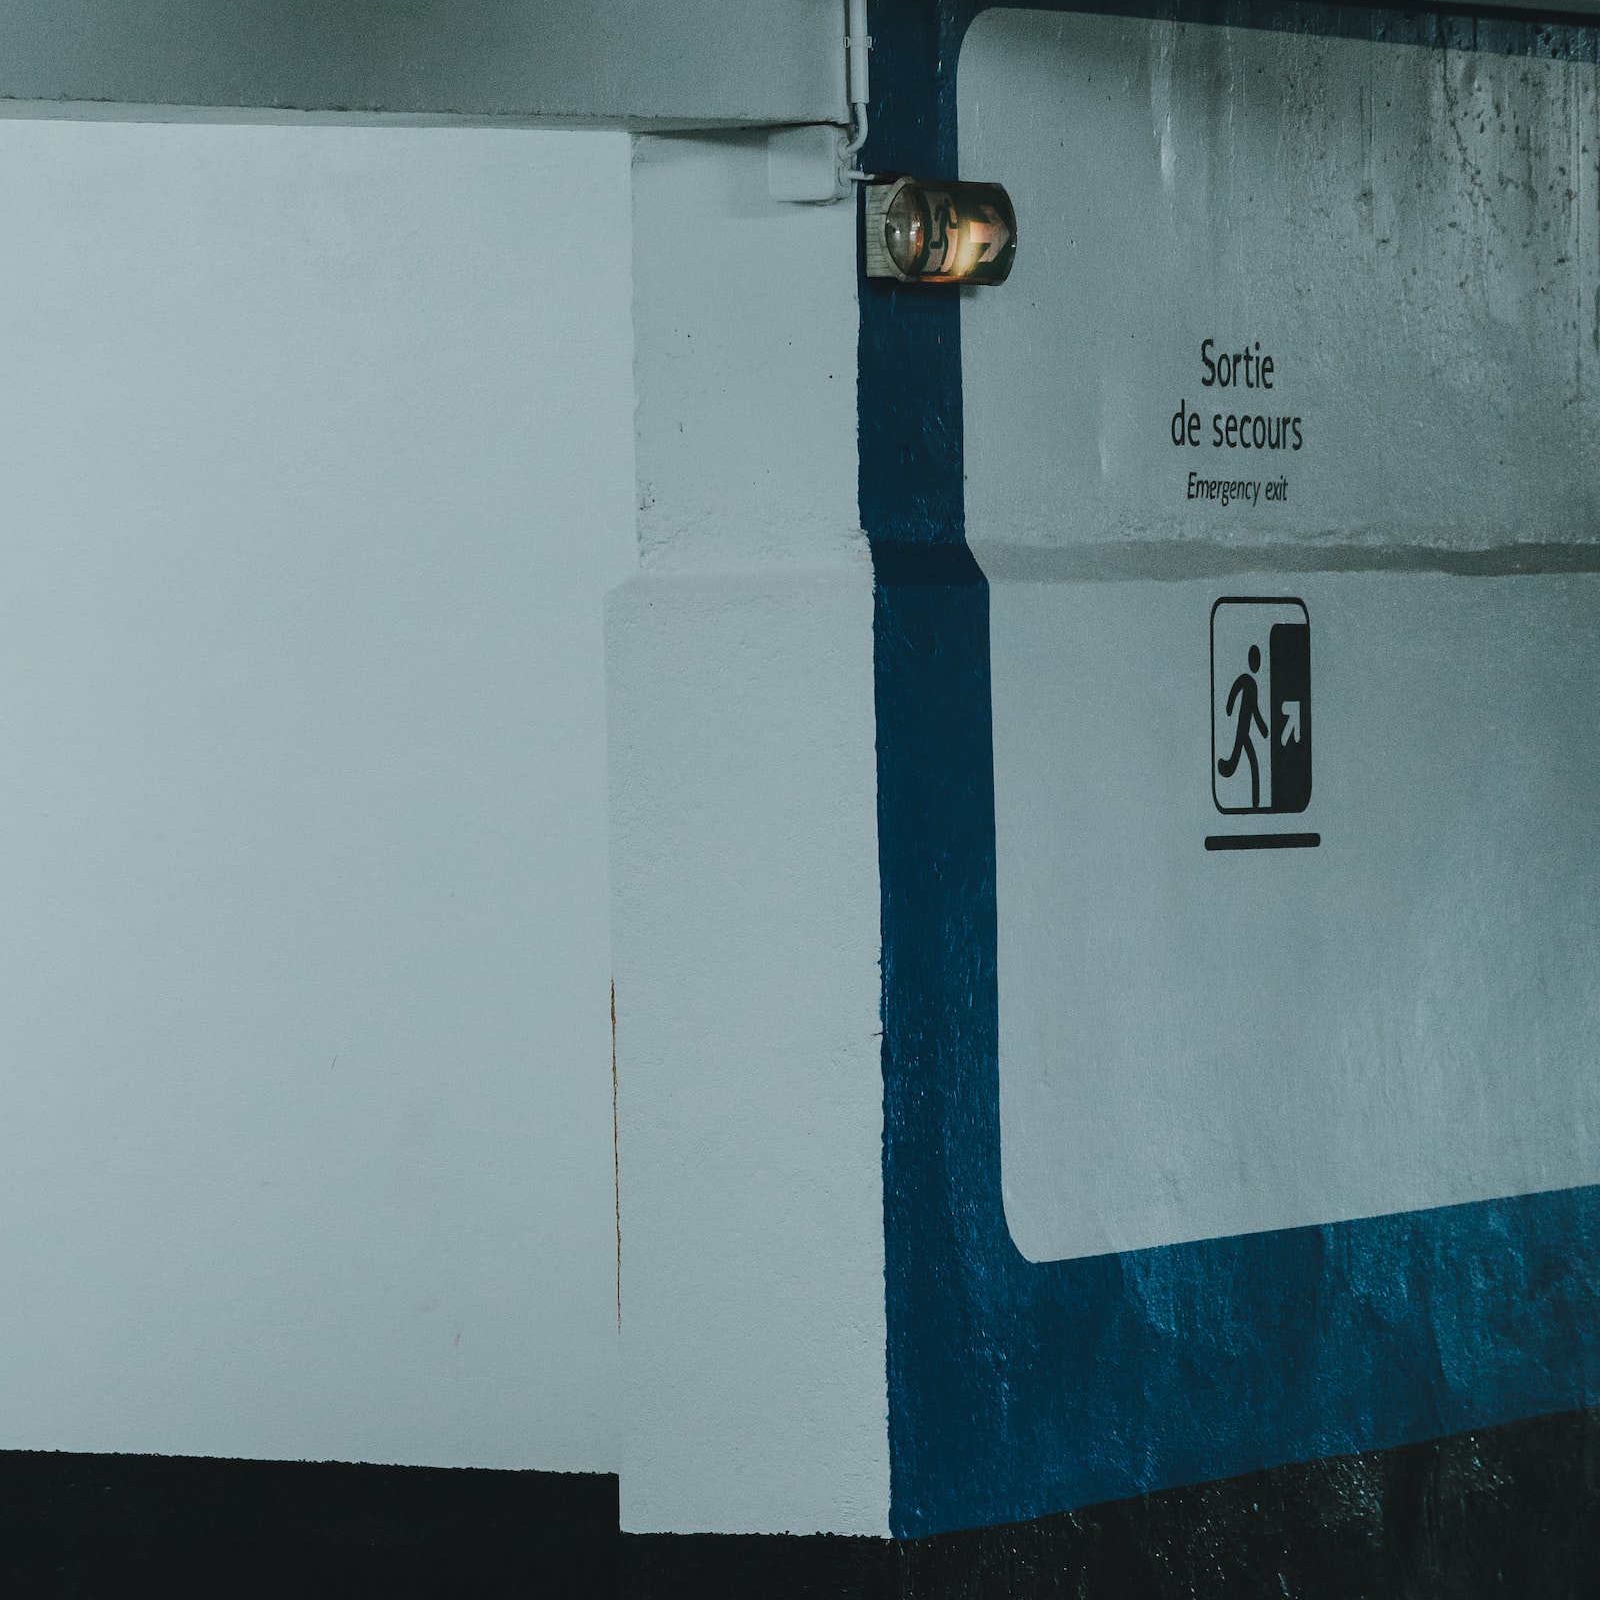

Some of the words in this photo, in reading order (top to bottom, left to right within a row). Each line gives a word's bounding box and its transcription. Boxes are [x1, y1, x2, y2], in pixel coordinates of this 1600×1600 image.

[1201, 338, 1274, 389] Sortie
[1171, 398, 1201, 447] de
[1212, 413, 1303, 451] secours
[1187, 471, 1261, 508] Emergency
[1265, 474, 1289, 501] exit
